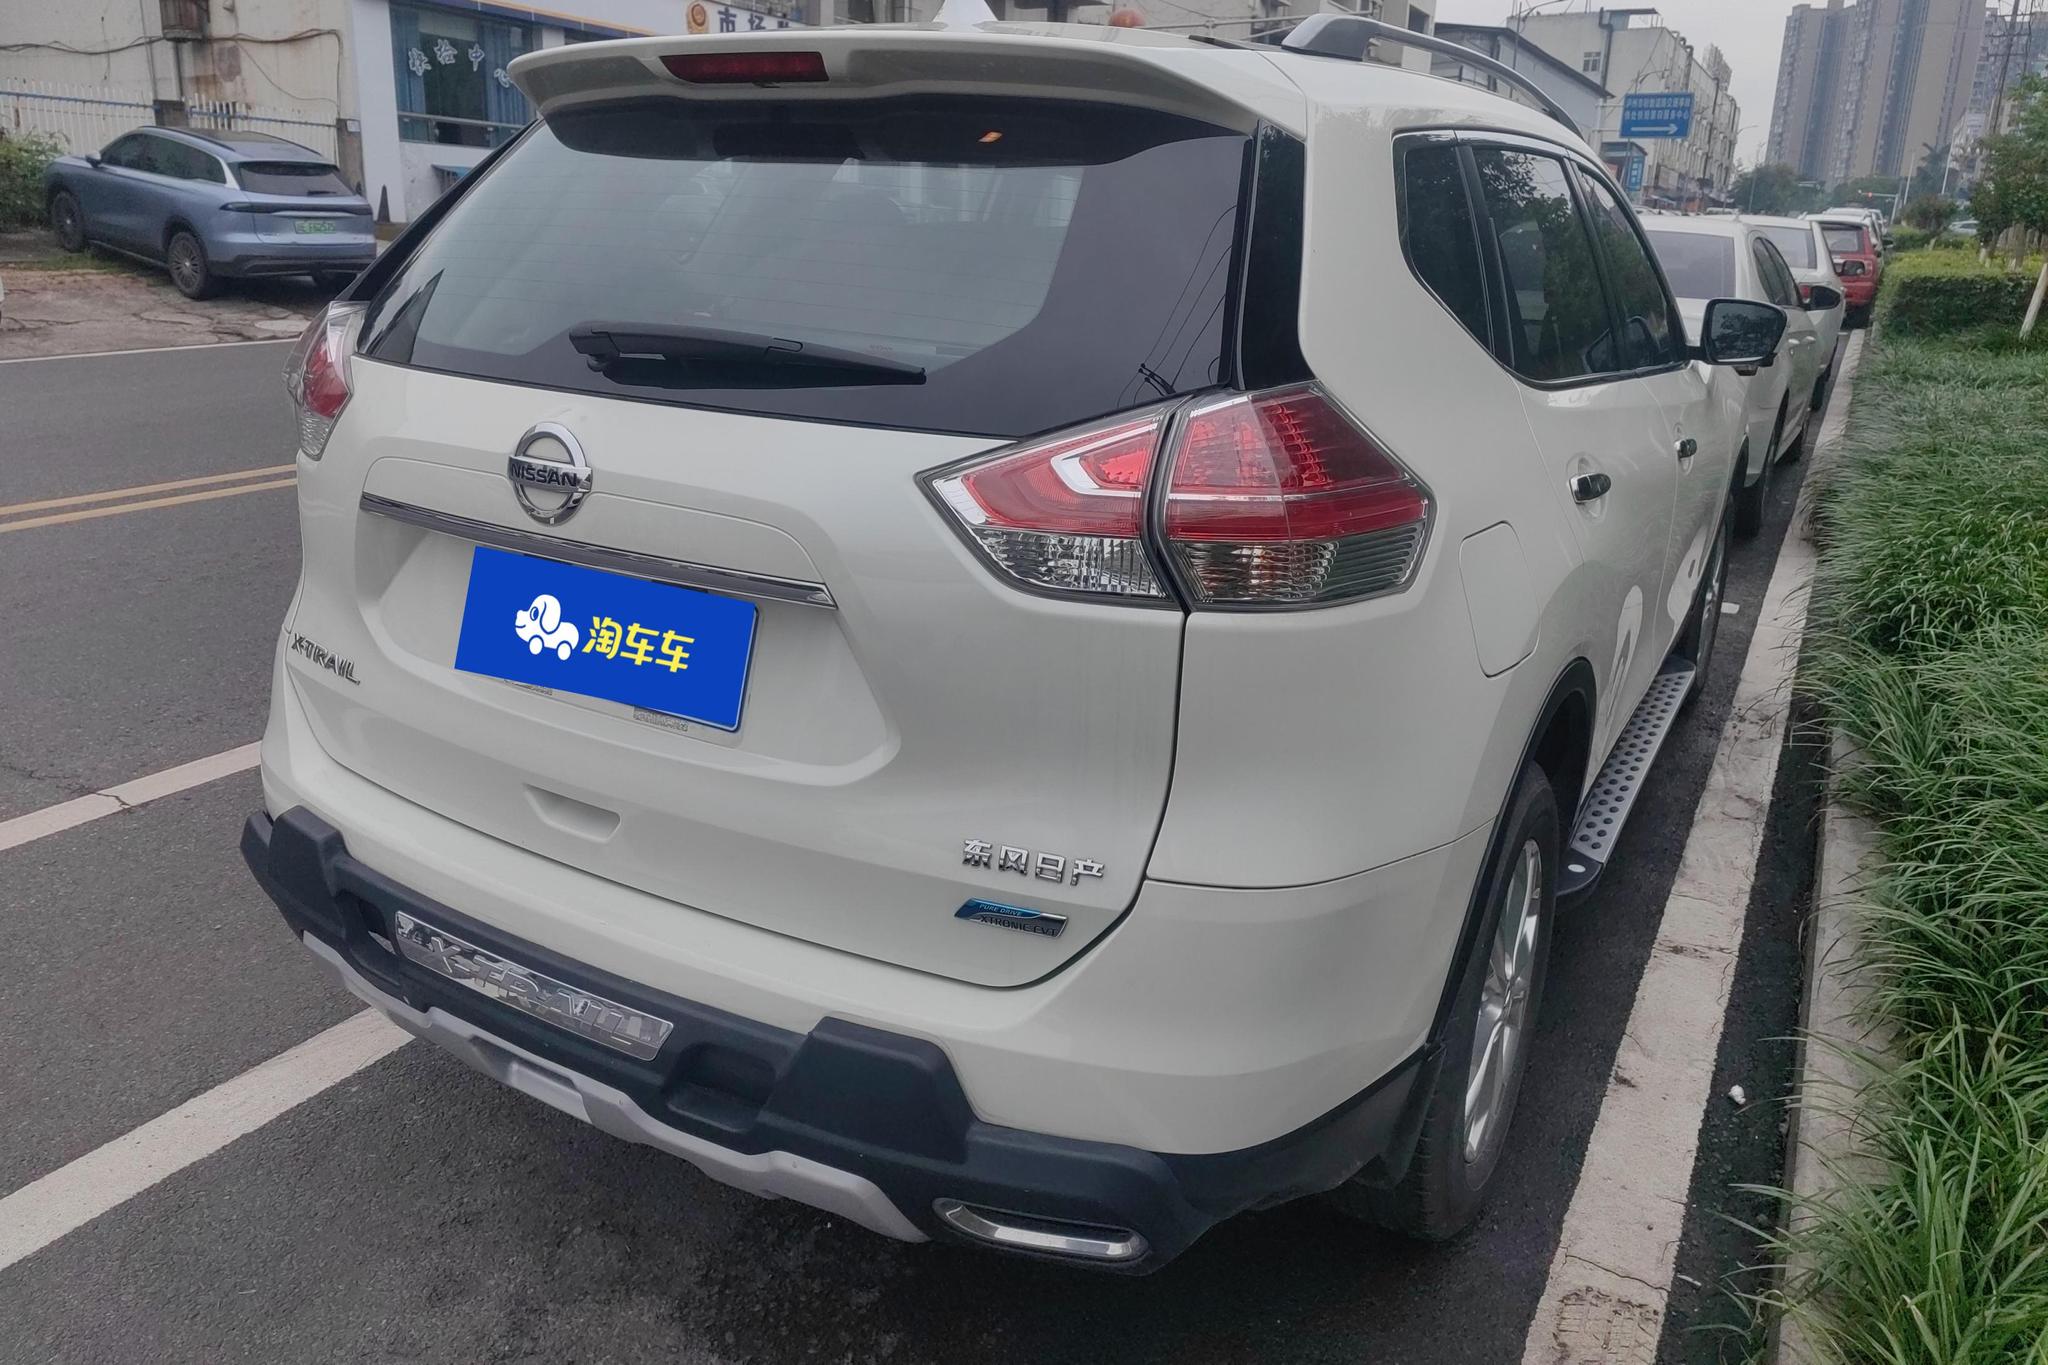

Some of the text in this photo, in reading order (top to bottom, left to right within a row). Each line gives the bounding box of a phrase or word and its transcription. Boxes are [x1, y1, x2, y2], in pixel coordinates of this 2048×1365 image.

[511, 463, 578, 487] NISSAN
[291, 632, 361, 686] X-TRAIL
[962, 838, 1105, 886] 东风日产
[979, 903, 1023, 917] PURE DRIVE
[979, 914, 1058, 937] XTRONIC CVT
